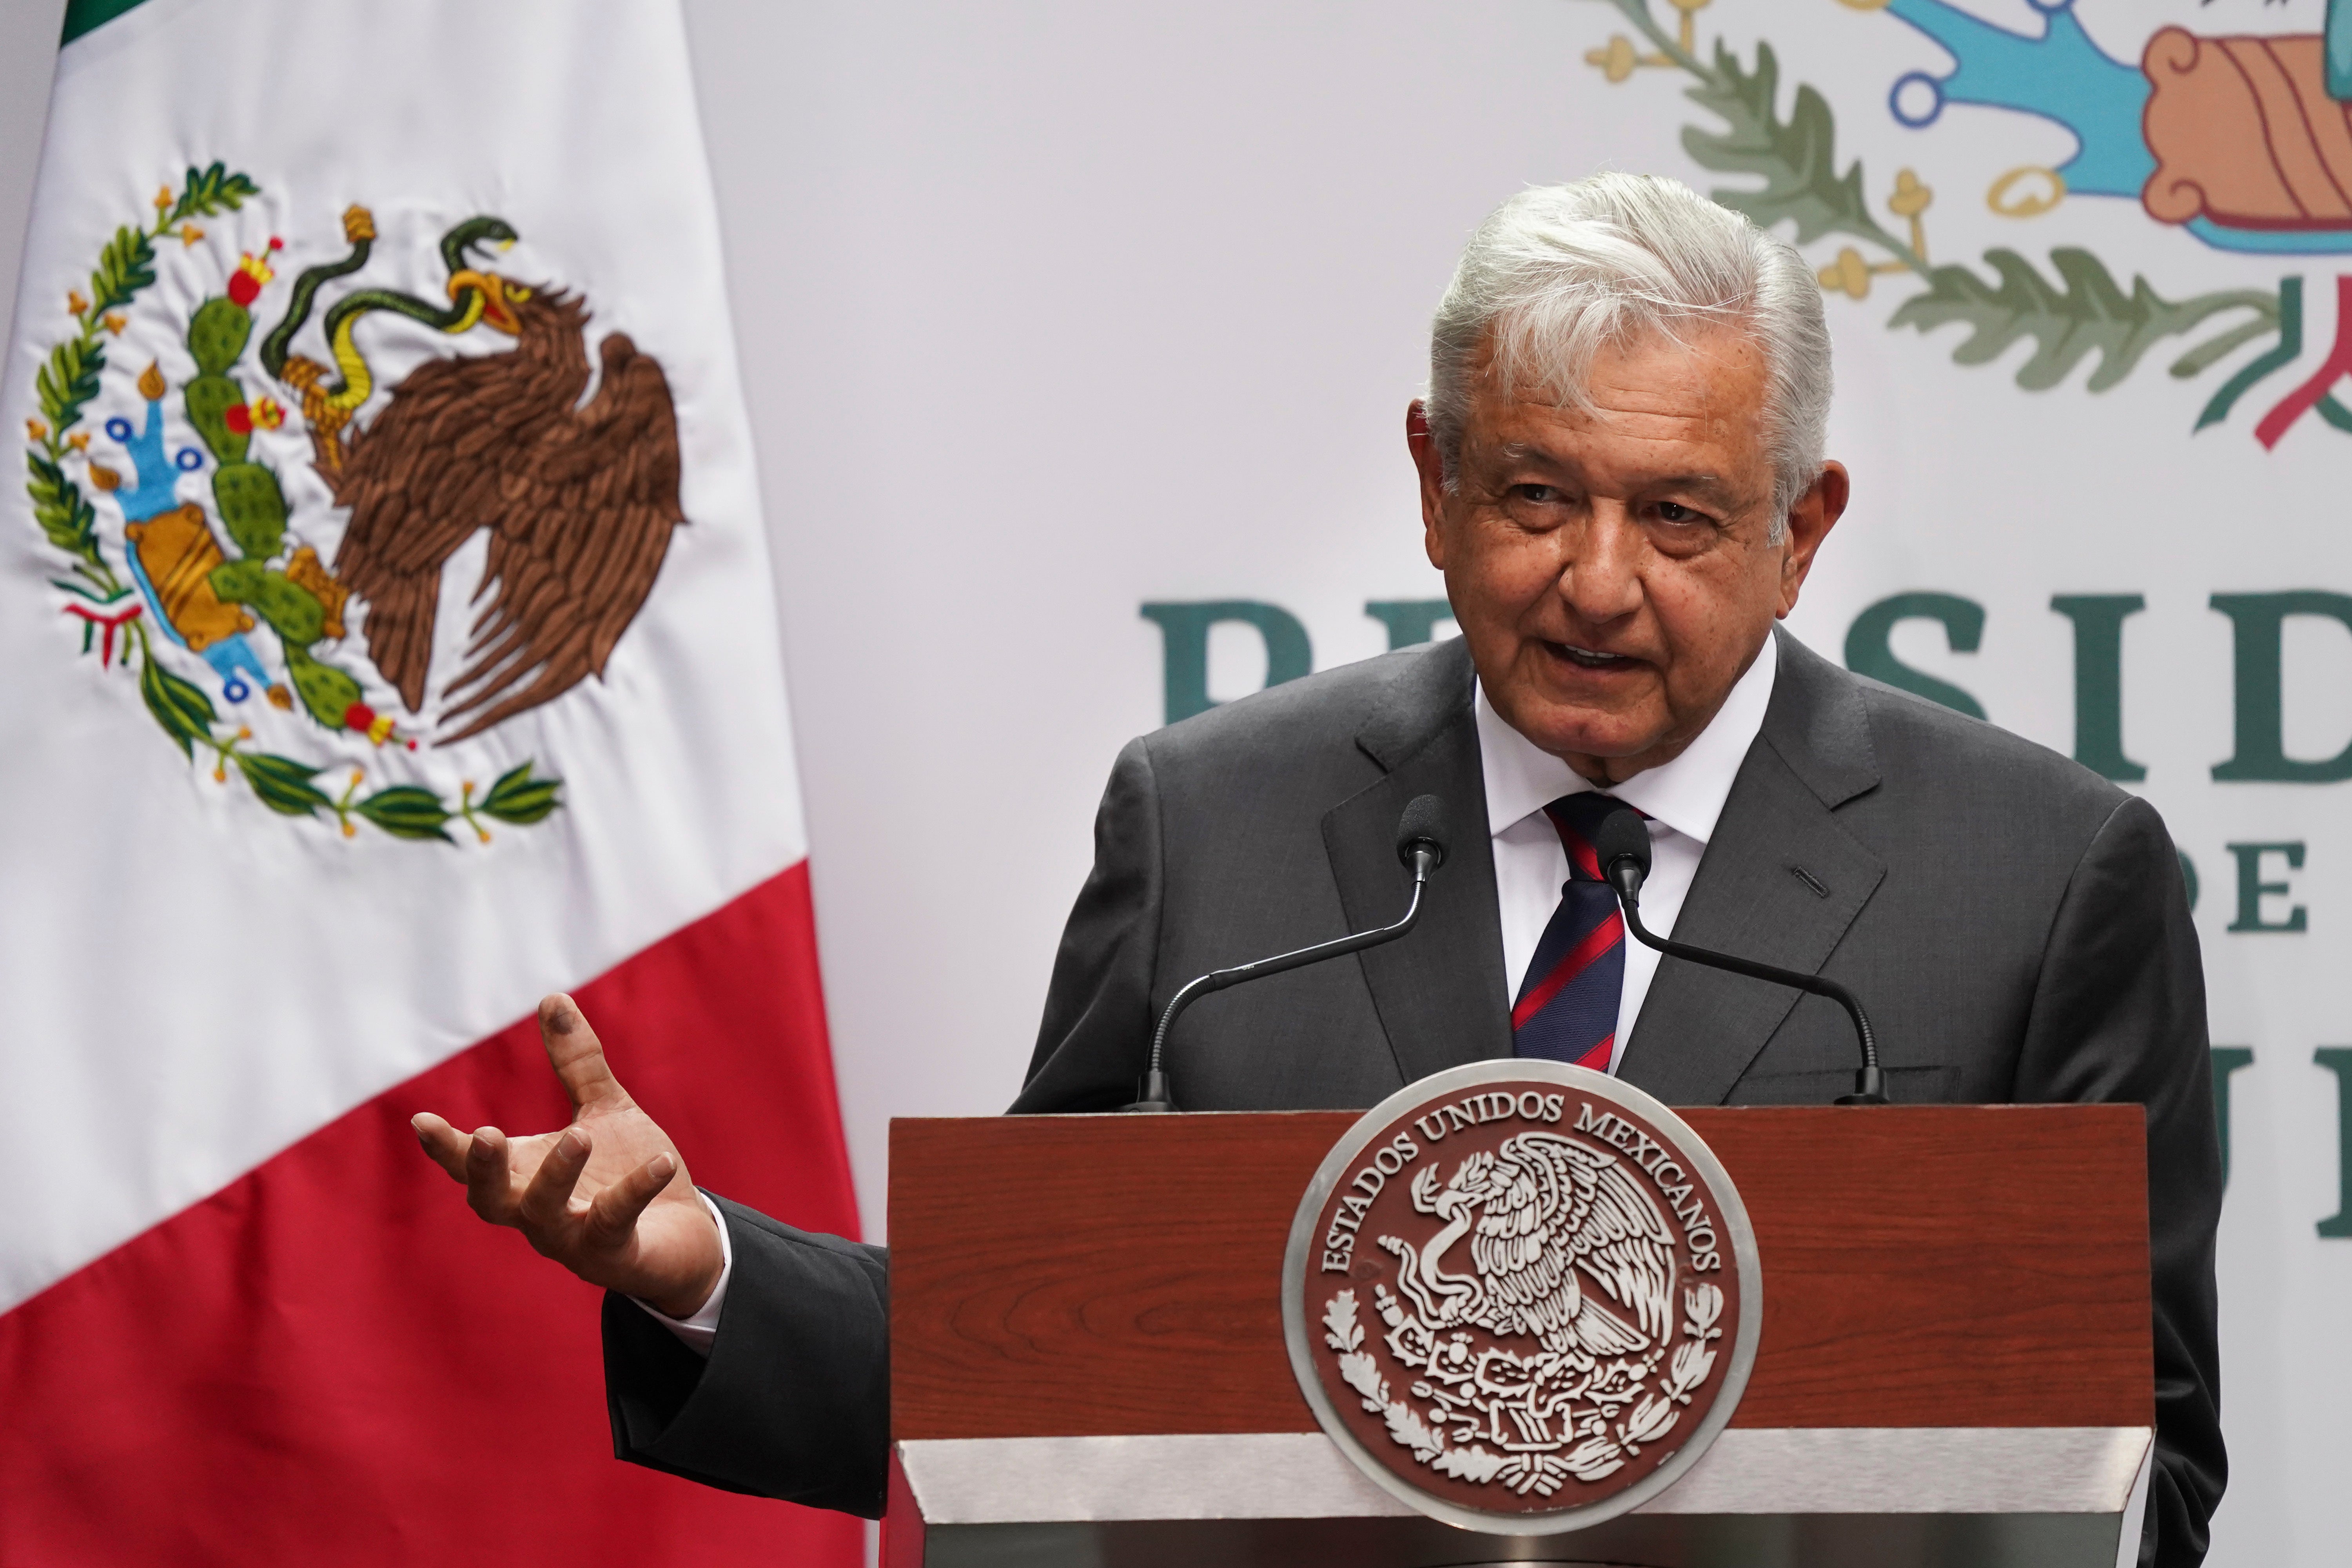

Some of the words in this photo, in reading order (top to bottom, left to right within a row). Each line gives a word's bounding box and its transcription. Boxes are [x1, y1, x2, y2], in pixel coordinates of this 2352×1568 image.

[2176, 840, 2307, 933] E
[1321, 1131, 1419, 1273] ESTADOS
[1414, 1091, 1565, 1141] UNIDOS
[1573, 1102, 1721, 1272] MEXICANOS
